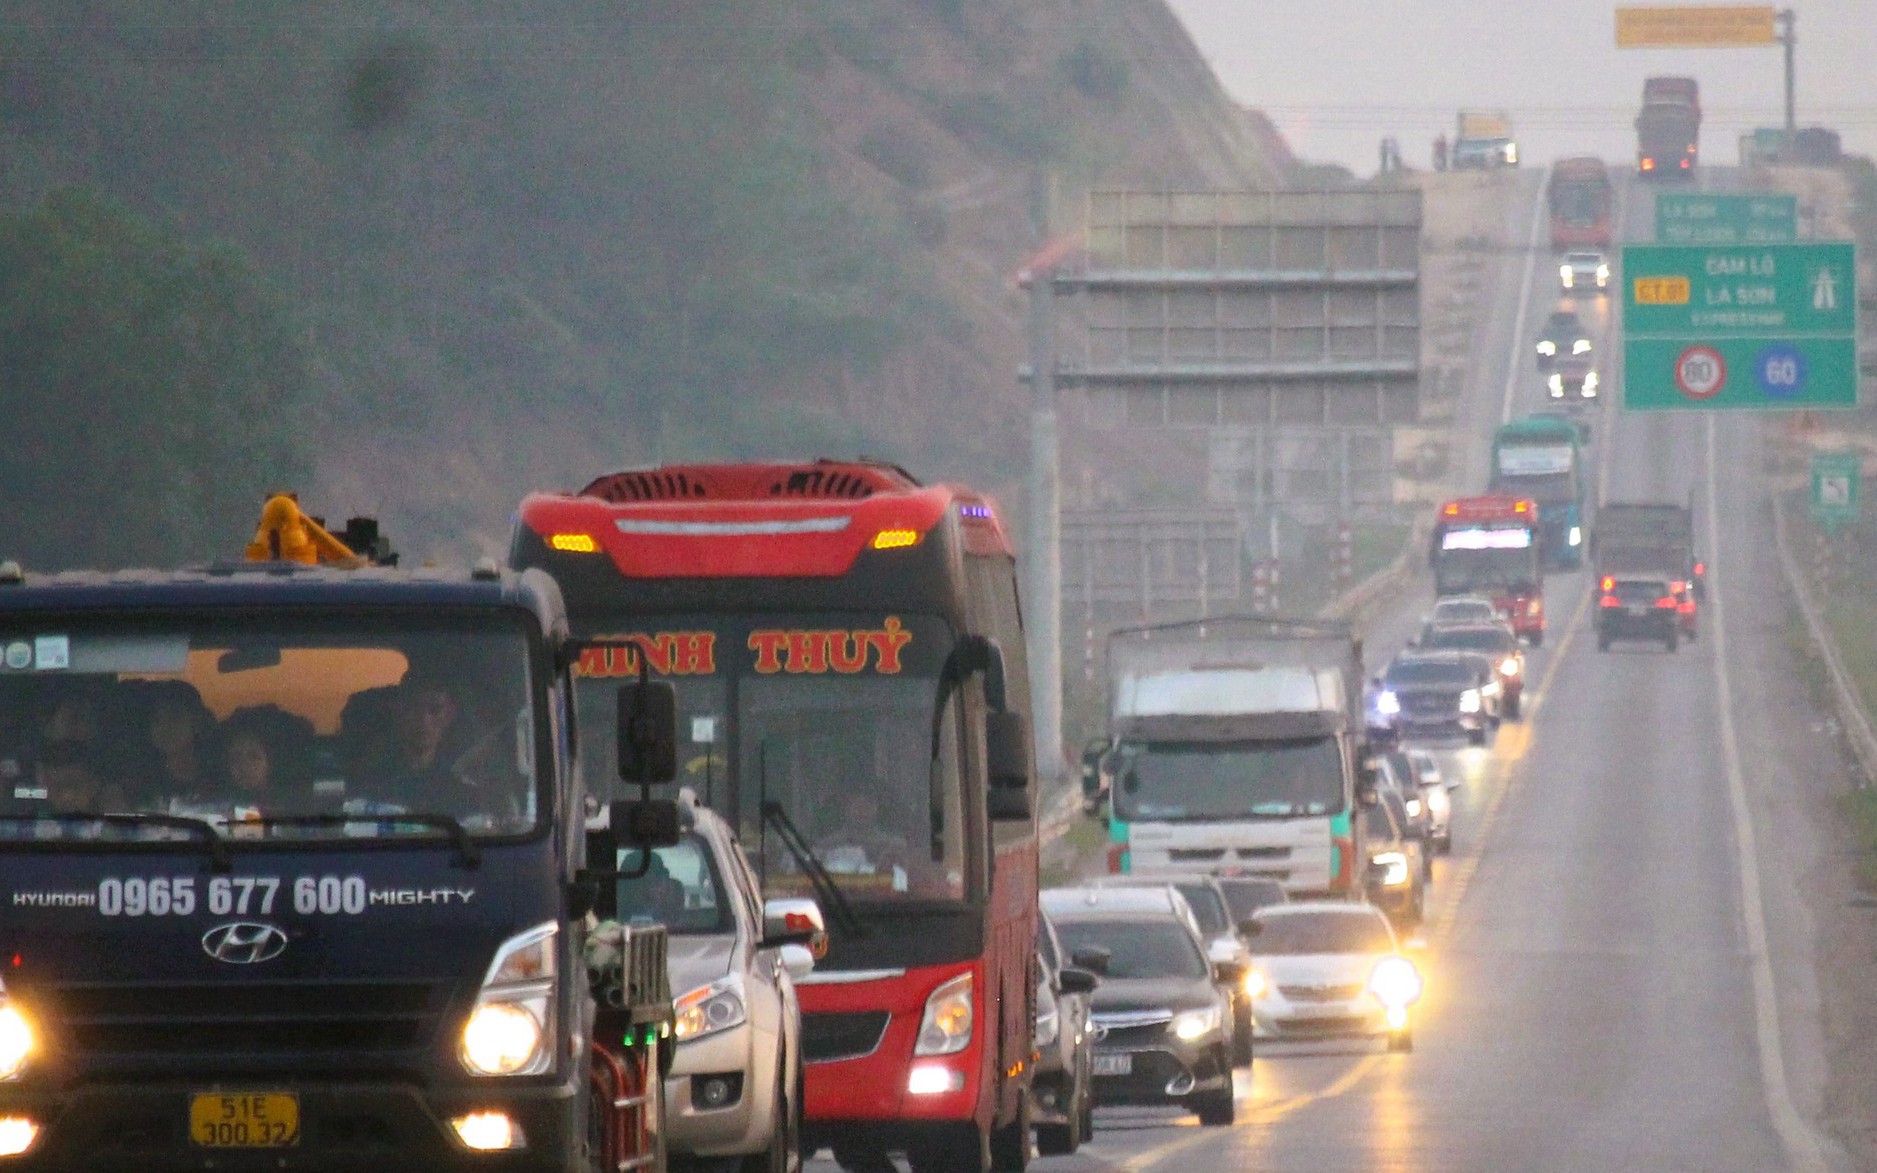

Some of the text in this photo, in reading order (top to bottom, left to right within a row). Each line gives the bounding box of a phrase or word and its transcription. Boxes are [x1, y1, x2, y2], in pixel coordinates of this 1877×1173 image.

[1765, 356, 1798, 386] 60
[13, 892, 96, 907] HYUNDAI
[99, 876, 366, 917] 0965 677 600
[368, 888, 475, 906] MIGHTY
[220, 1096, 267, 1120] 51E
